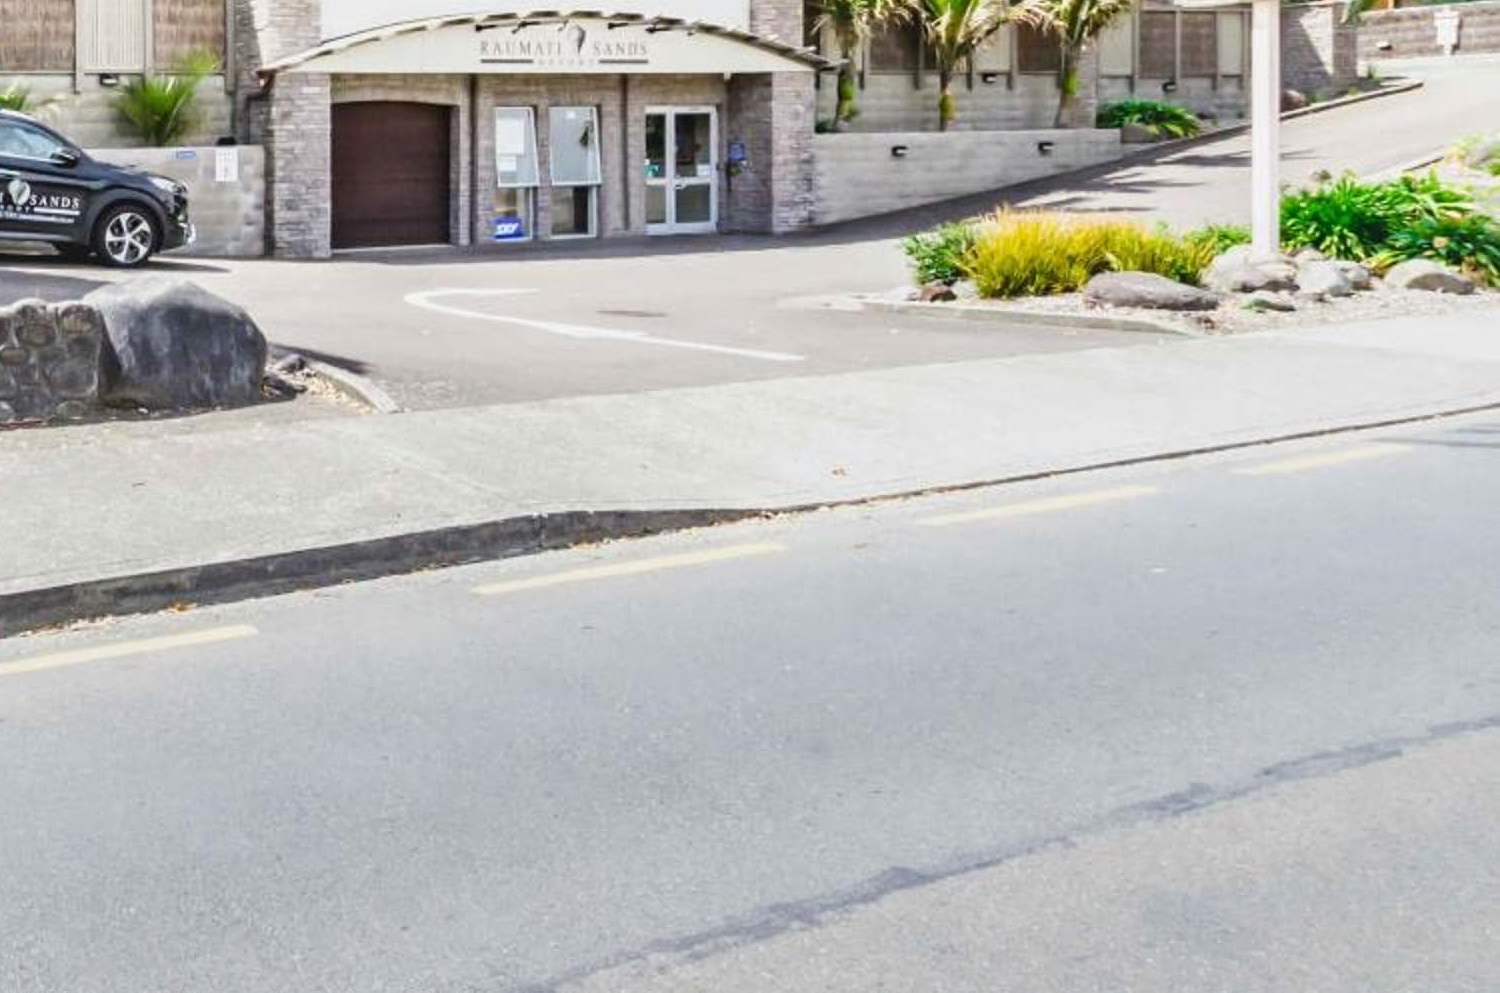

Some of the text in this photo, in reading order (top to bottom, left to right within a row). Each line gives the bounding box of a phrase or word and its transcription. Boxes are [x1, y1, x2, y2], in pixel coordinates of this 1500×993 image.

[480, 40, 647, 55] RAUMATI SANDS
[30, 194, 80, 209] SANDS
